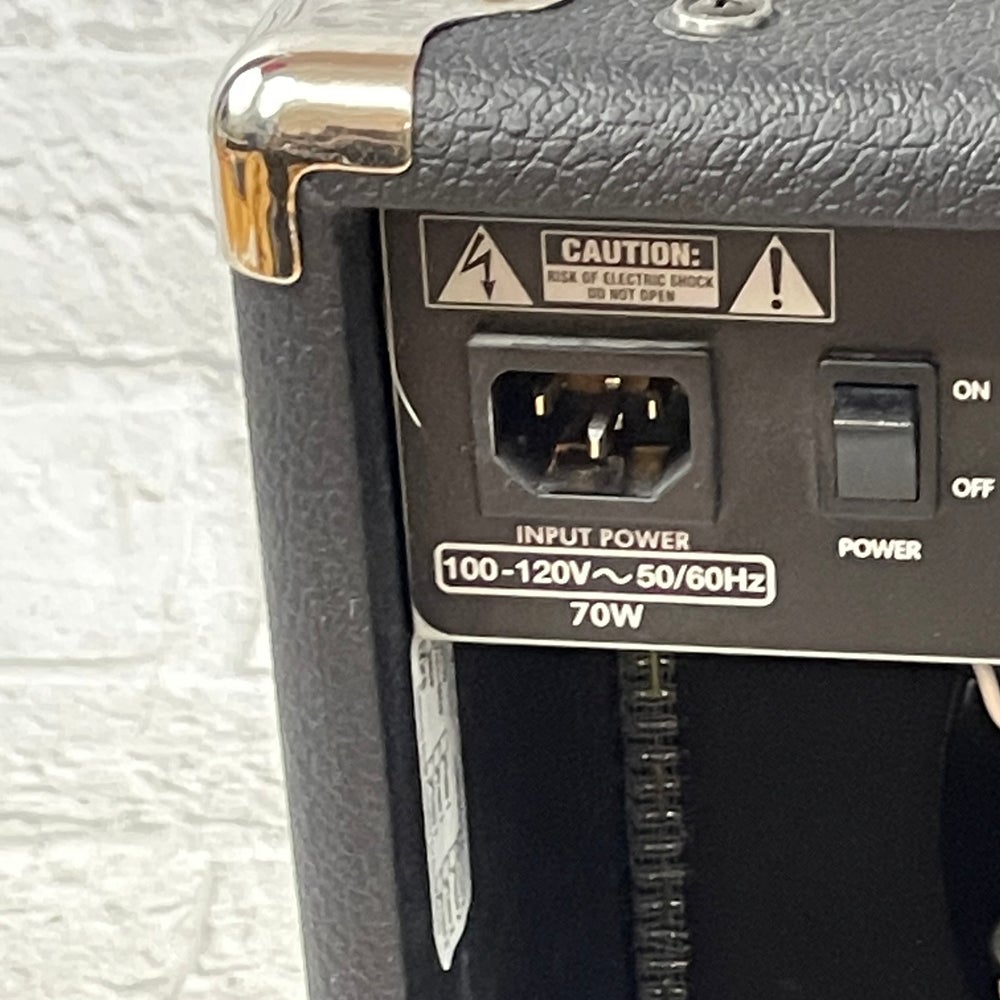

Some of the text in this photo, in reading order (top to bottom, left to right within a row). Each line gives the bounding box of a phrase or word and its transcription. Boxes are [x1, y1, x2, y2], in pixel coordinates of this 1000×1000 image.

[561, 237, 700, 267] CAUTION:
[547, 270, 714, 288] RISK OF ELECTRIC SHOCK
[587, 288, 676, 302] DO NOT OPEN
[952, 379, 991, 402] ON
[951, 476, 996, 499] OFF
[516, 524, 690, 551] INPUT POWER
[837, 536, 923, 561] POWER
[570, 601, 644, 630] 70W
